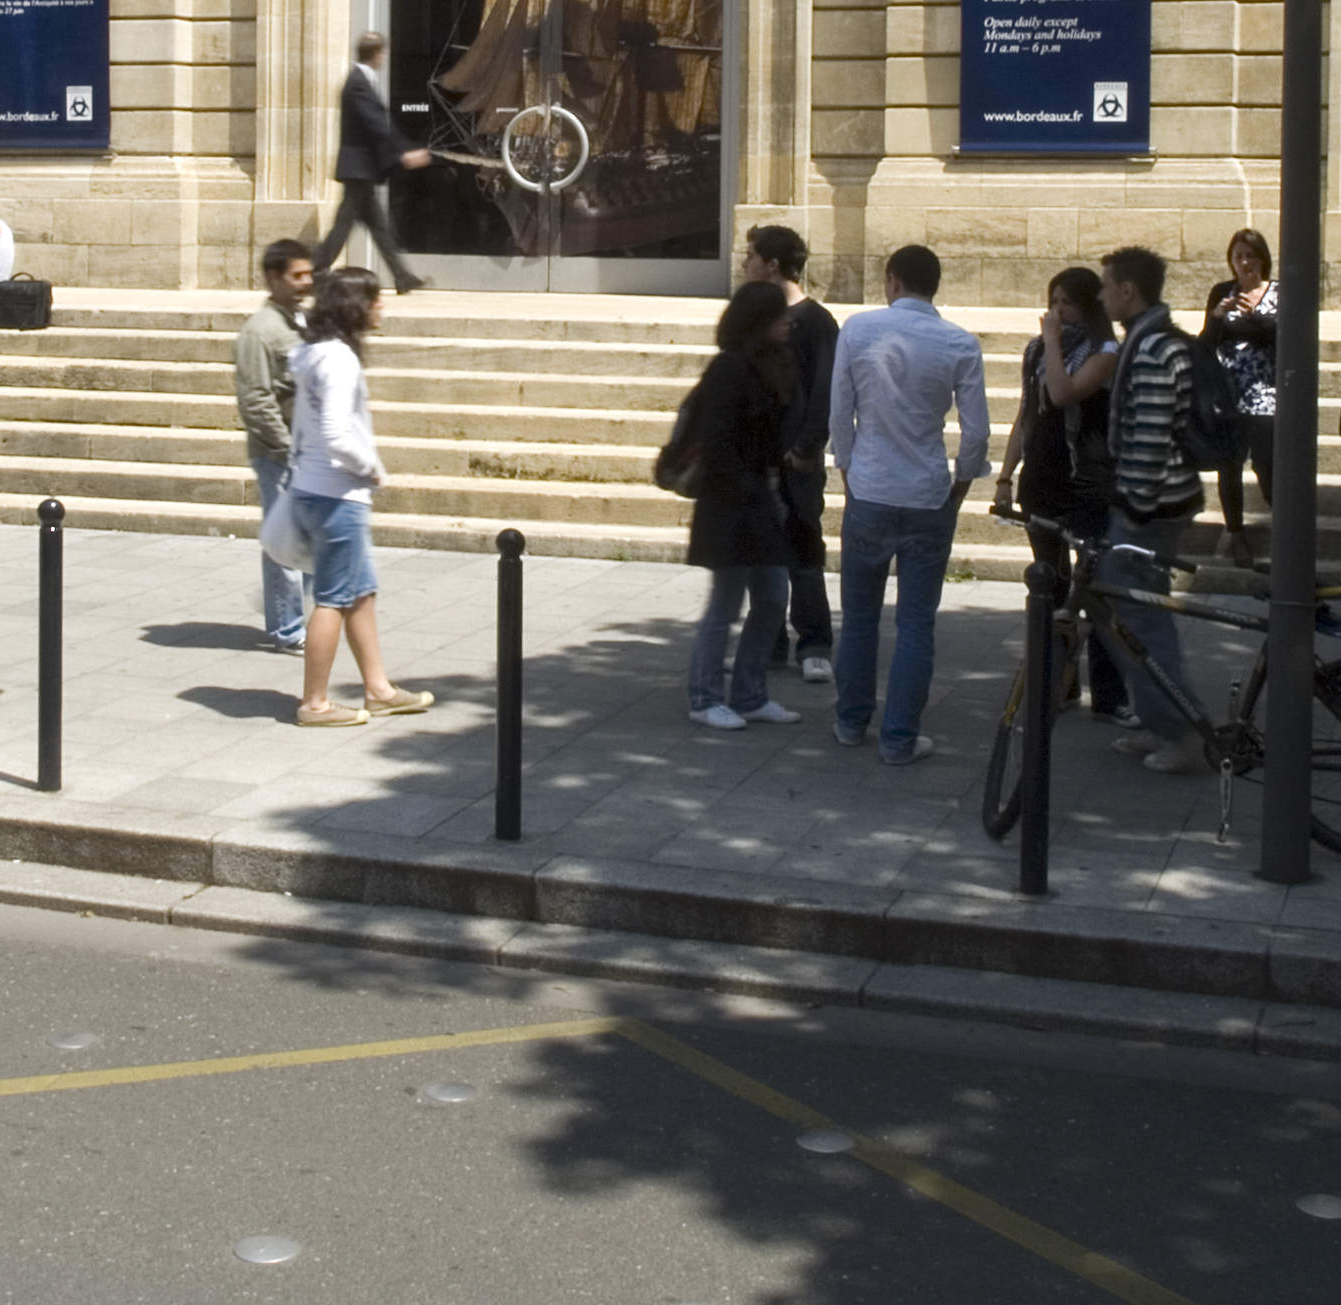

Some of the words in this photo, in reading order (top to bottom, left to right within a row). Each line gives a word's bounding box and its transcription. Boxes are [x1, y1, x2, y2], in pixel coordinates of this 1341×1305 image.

[984, 17, 1013, 30] Open
[1014, 16, 1042, 29] daily
[1043, 18, 1078, 29] except
[983, 28, 1032, 42] Mondays
[1034, 29, 1055, 40] and
[1056, 28, 1101, 42] holidays
[984, 42, 997, 53] 11
[999, 45, 1020, 53] a.m
[1031, 42, 1039, 53] 6
[1040, 44, 1061, 55] p.m
[402, 103, 429, 112] ENTRÉE
[984, 110, 1083, 122] www.bordeaux.fr
